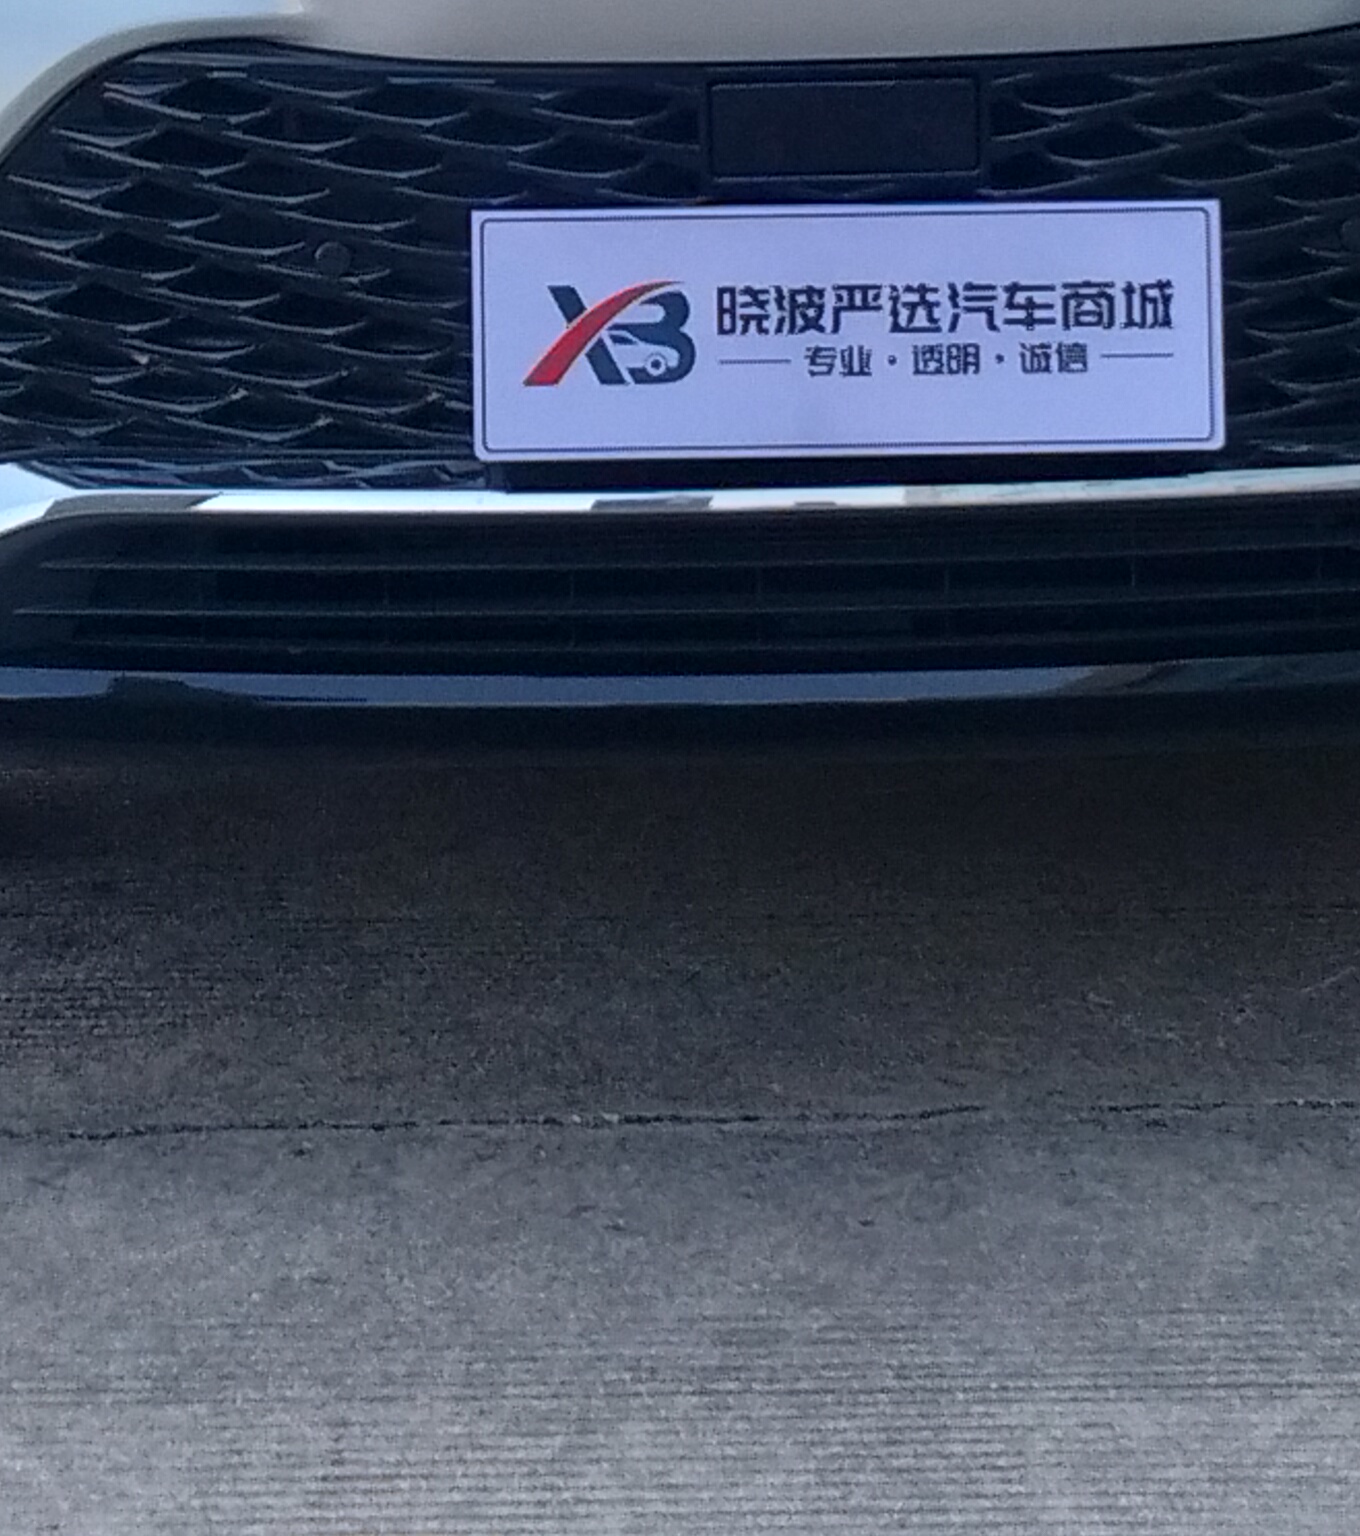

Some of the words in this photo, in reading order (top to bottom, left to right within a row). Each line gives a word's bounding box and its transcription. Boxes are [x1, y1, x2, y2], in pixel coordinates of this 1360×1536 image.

[715, 278, 1175, 337] 晓波严选汽车商城
